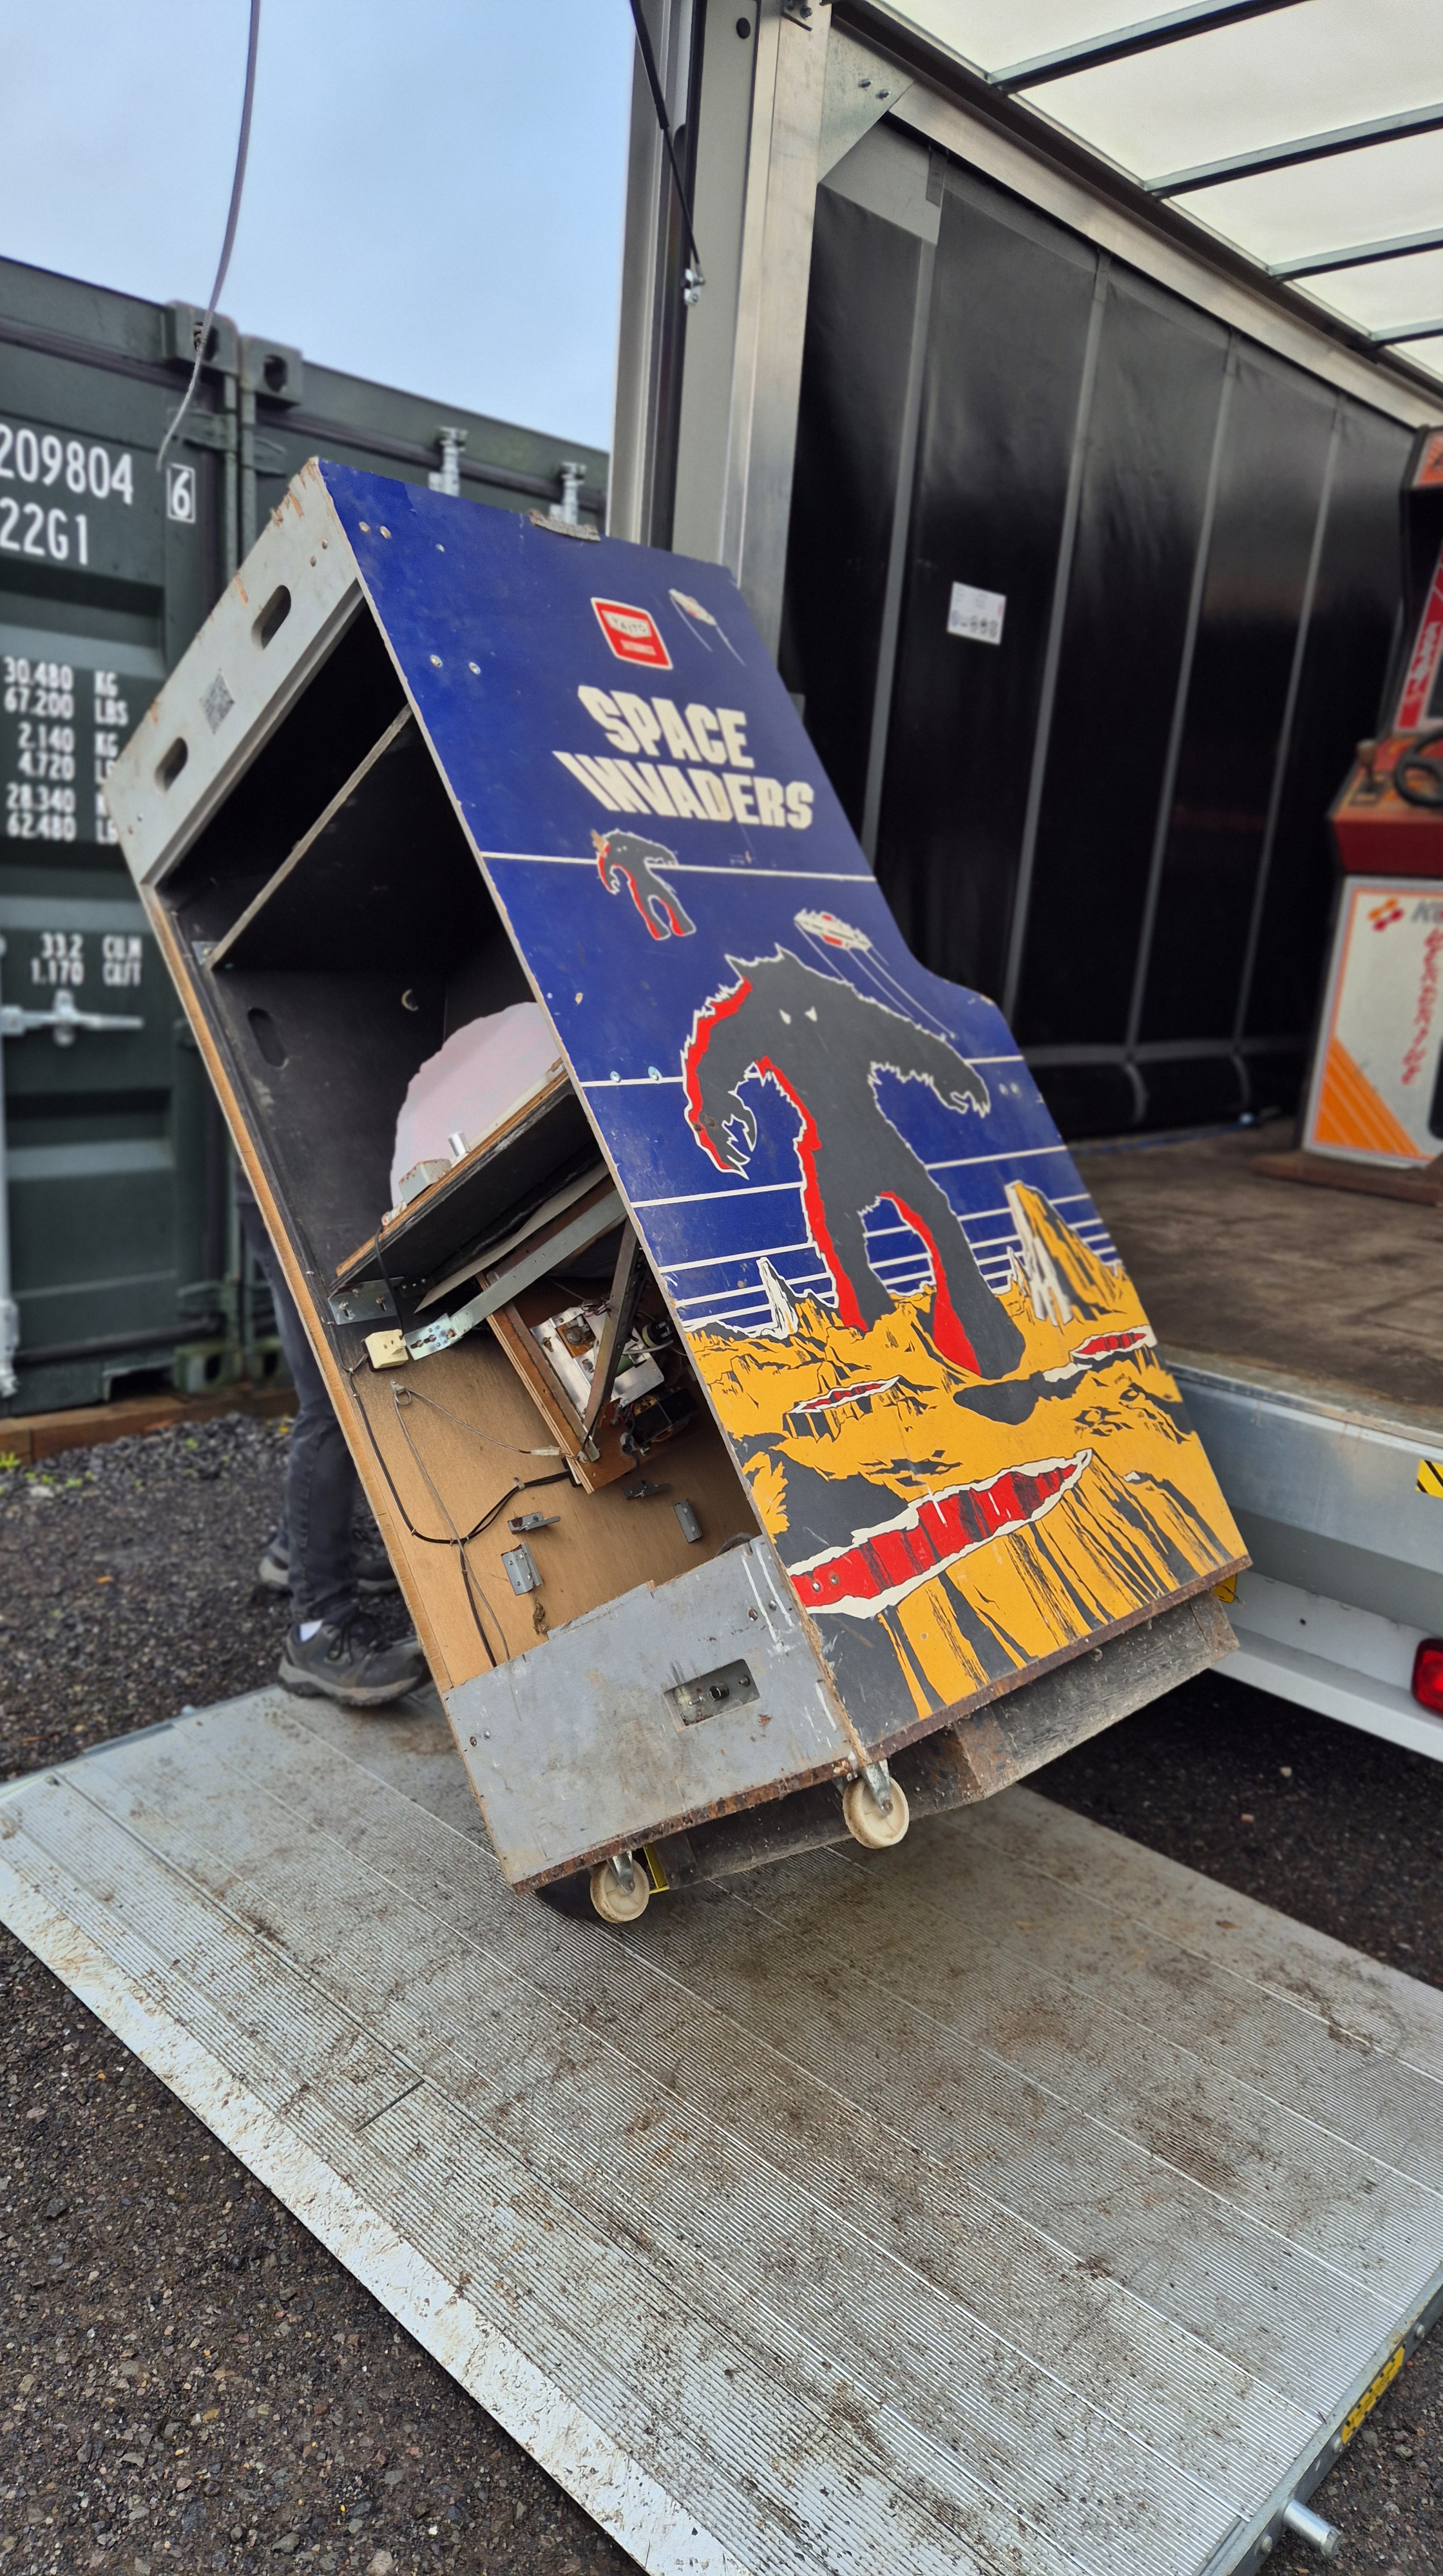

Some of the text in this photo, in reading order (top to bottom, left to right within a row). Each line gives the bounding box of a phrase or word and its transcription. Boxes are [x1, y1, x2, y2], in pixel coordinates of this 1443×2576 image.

[0, 423, 191, 517] 209804 6
[0, 497, 88, 565] 22G1
[611, 616, 647, 633] TAITO
[95, 697, 128, 726] LBS
[578, 685, 755, 768] SPACE
[552, 751, 814, 829] INVADERS
